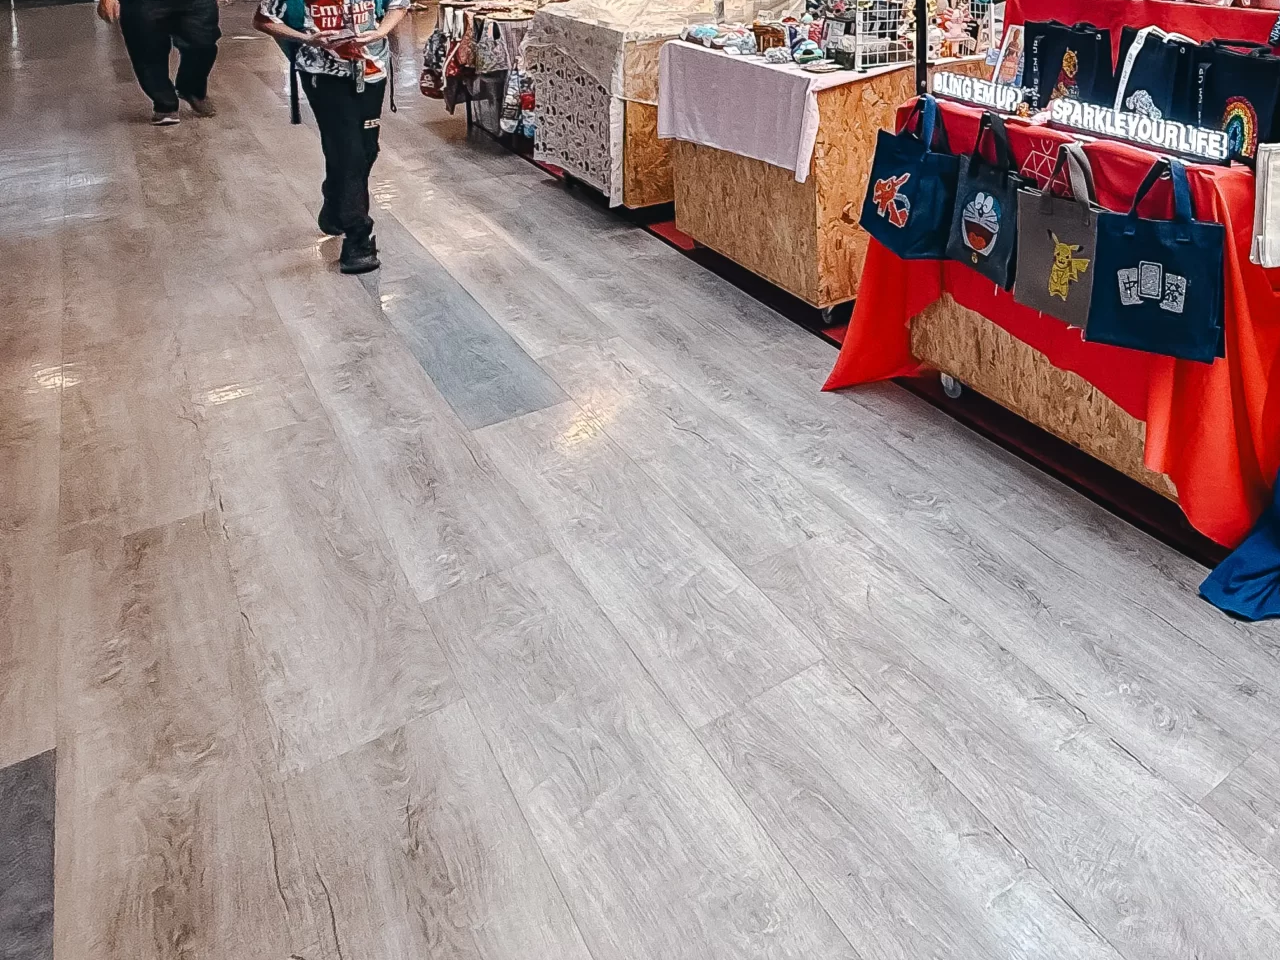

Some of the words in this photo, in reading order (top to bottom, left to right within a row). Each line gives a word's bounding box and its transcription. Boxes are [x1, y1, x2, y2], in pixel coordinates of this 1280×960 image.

[321, 16, 338, 28] FLY
[933, 72, 972, 100] BLING
[1052, 98, 1128, 135] SPARKLE
[1124, 113, 1183, 149] YOUR
